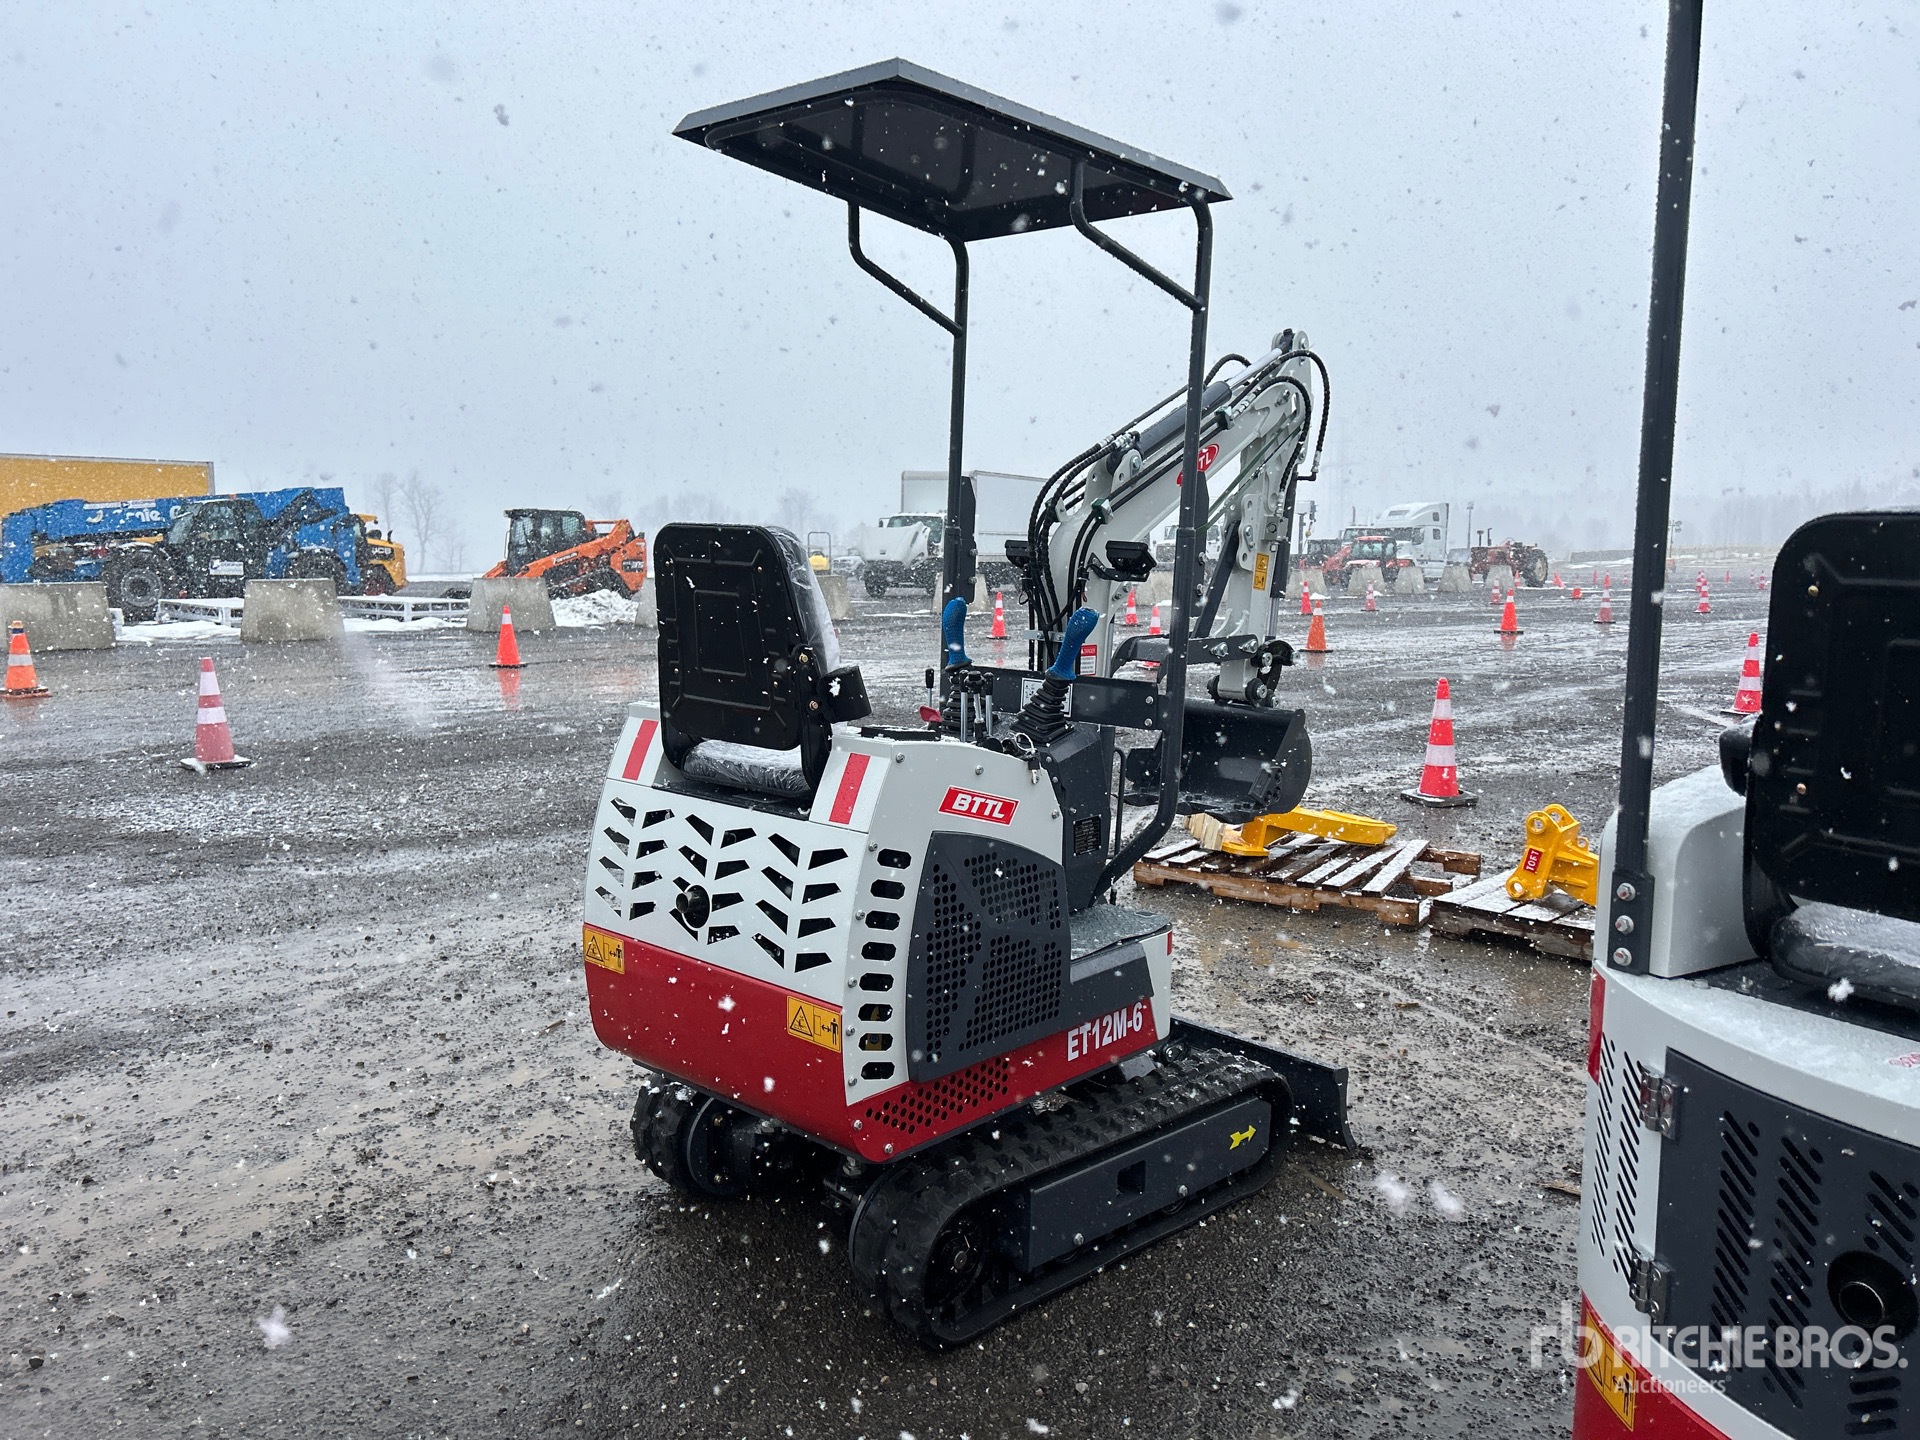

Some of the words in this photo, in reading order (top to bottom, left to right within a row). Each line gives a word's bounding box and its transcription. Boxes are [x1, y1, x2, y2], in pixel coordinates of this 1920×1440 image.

[952, 793, 1005, 818] BTTL
[1525, 850, 1539, 871] TOFT
[1067, 1001, 1143, 1062] ET12M-6
